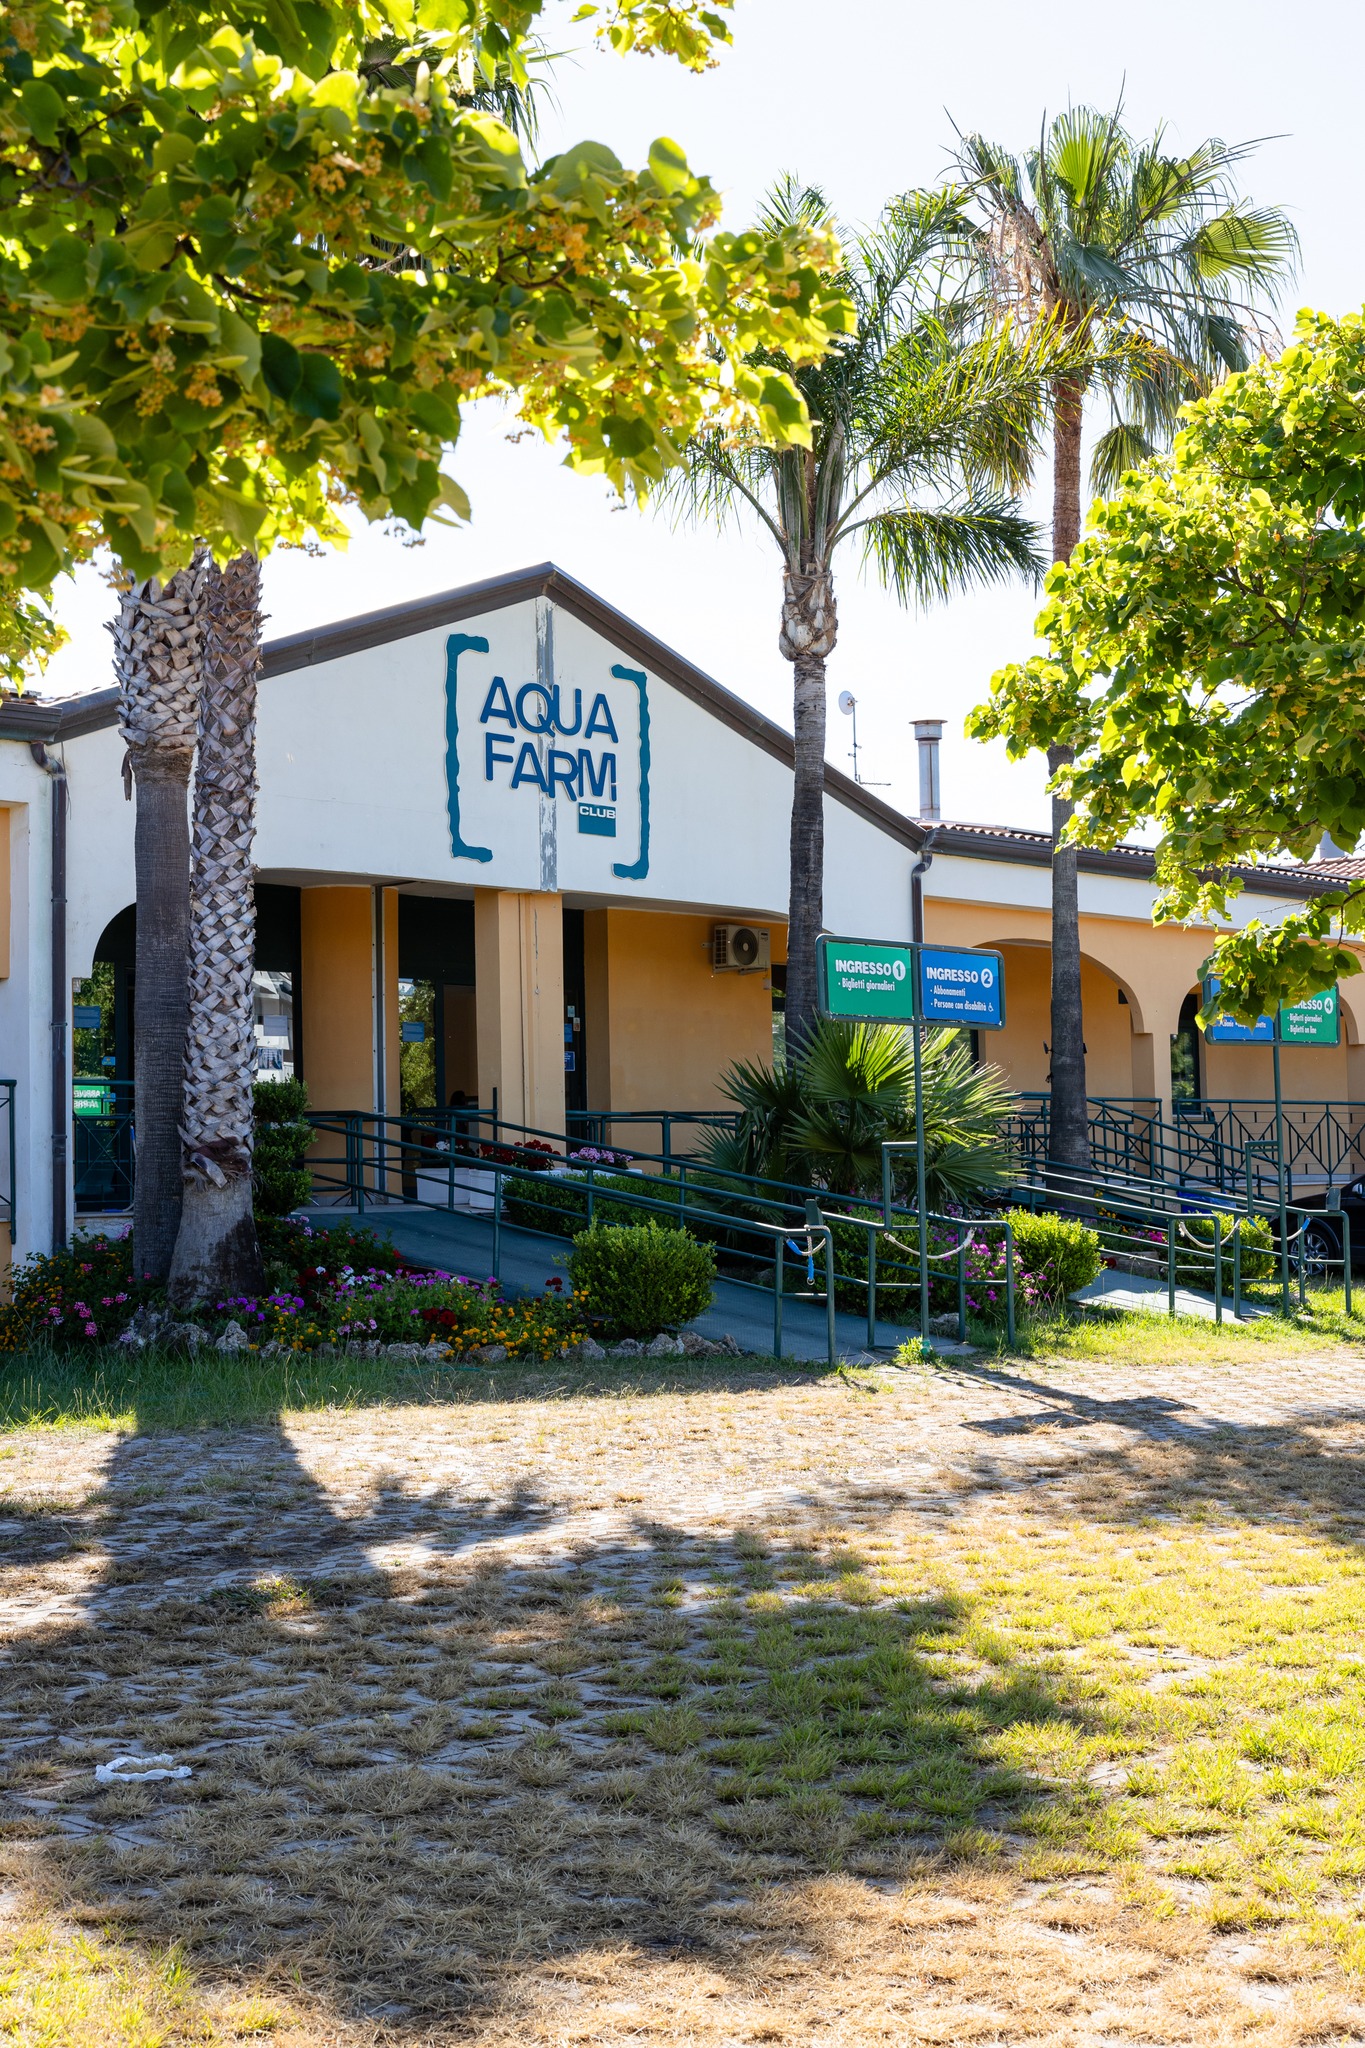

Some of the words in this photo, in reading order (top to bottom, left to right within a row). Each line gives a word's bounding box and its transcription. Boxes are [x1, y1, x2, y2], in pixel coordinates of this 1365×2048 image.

[480, 676, 618, 743] AQUA
[485, 732, 617, 802] FARM
[580, 806, 616, 819] CLUB
[835, 959, 892, 976] INGRESSO
[926, 967, 978, 983] INGRESSO
[842, 978, 865, 991] Biglietti
[866, 979, 895, 992] giornalieri
[934, 986, 966, 997] Abbonamenti
[934, 998, 954, 1009] Persone
[955, 1001, 963, 1010] con
